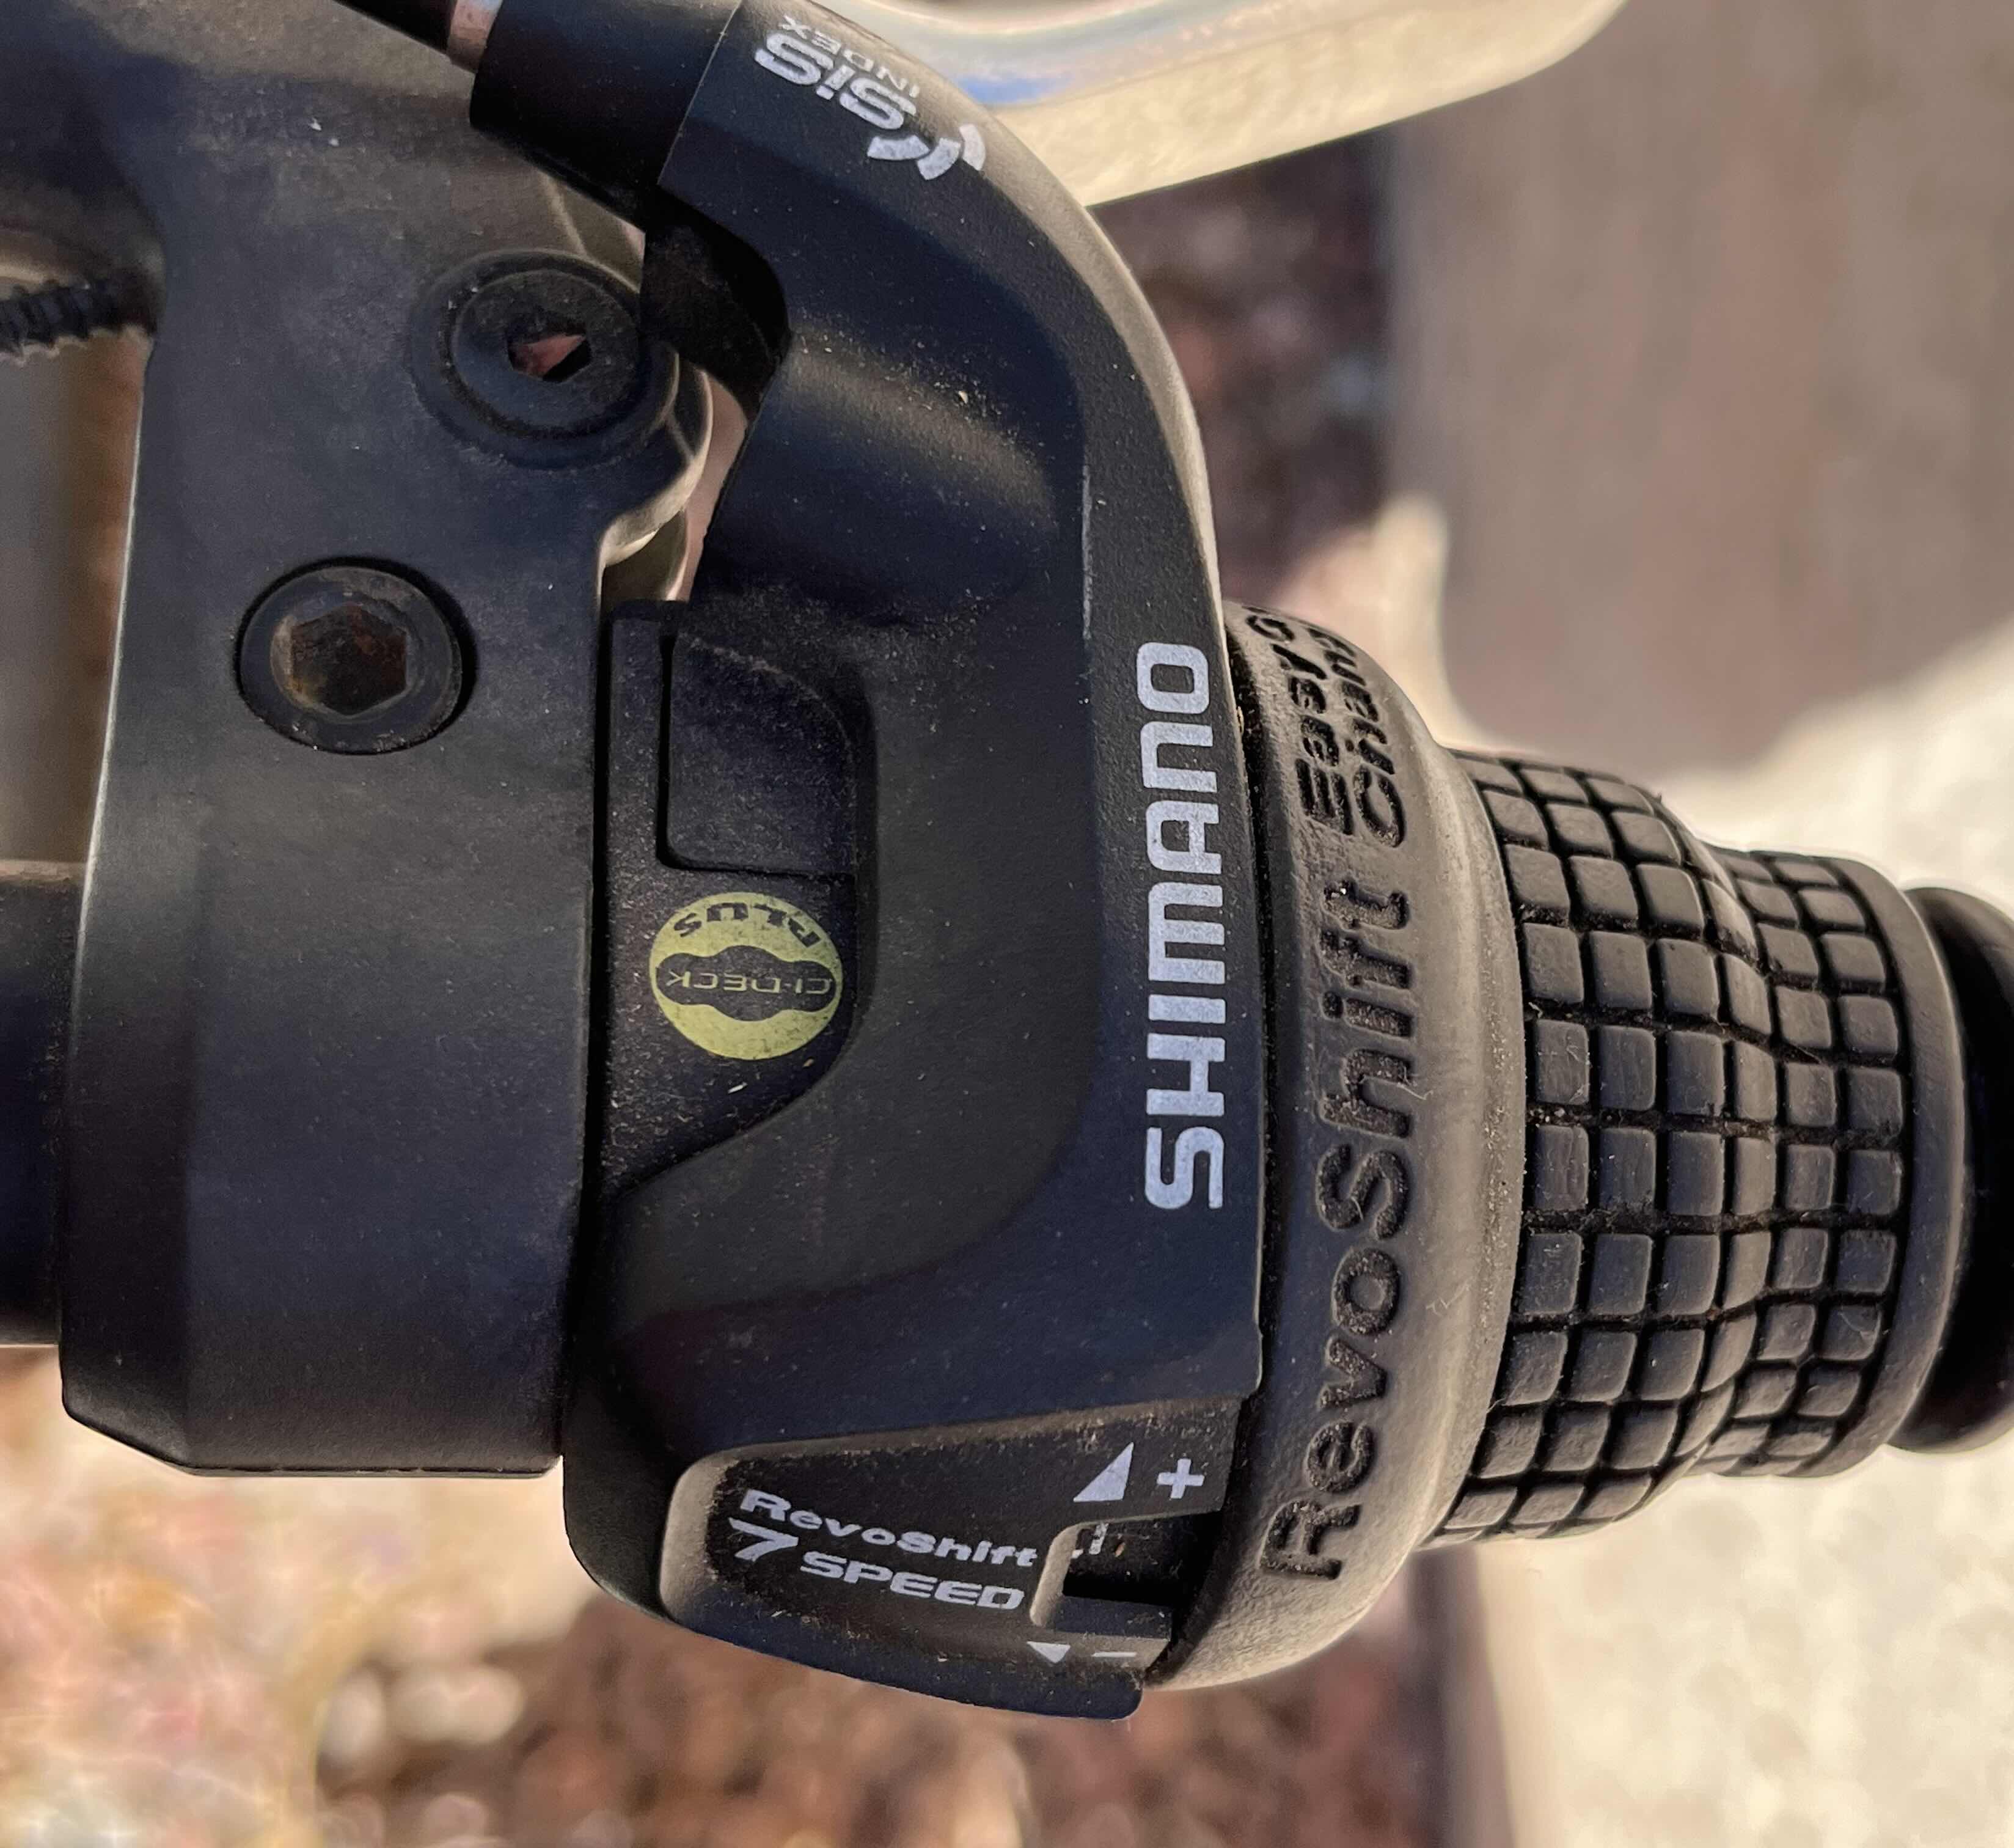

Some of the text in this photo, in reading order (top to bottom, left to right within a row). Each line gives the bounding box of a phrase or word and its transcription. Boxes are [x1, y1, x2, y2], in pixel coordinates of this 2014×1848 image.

[778, 15, 921, 98] INDEX
[673, 902, 821, 948] PLUS
[1137, 641, 1226, 1209] SHIMANO
[665, 970, 833, 996] CI-DECK
[1260, 879, 1412, 1580] RevoShift
[728, 1517, 1025, 1610] 7 SPEED
[739, 1489, 1038, 1569] RevoShift
